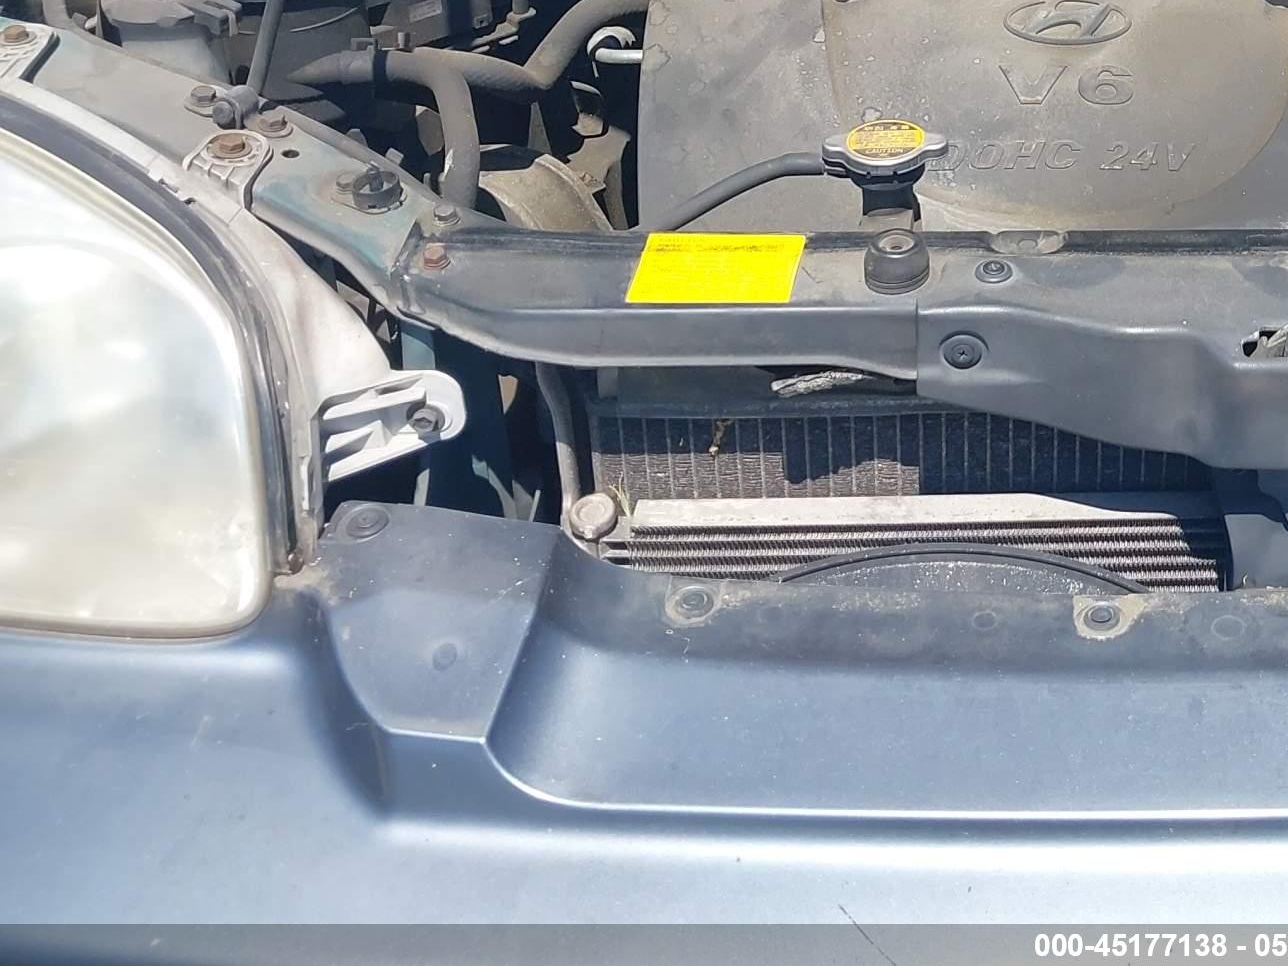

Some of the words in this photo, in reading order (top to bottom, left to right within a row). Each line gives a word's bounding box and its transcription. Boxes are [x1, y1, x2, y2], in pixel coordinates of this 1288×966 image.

[998, 64, 1136, 106] V6
[928, 139, 1081, 172] DOHC
[1099, 140, 1198, 172] 24V
